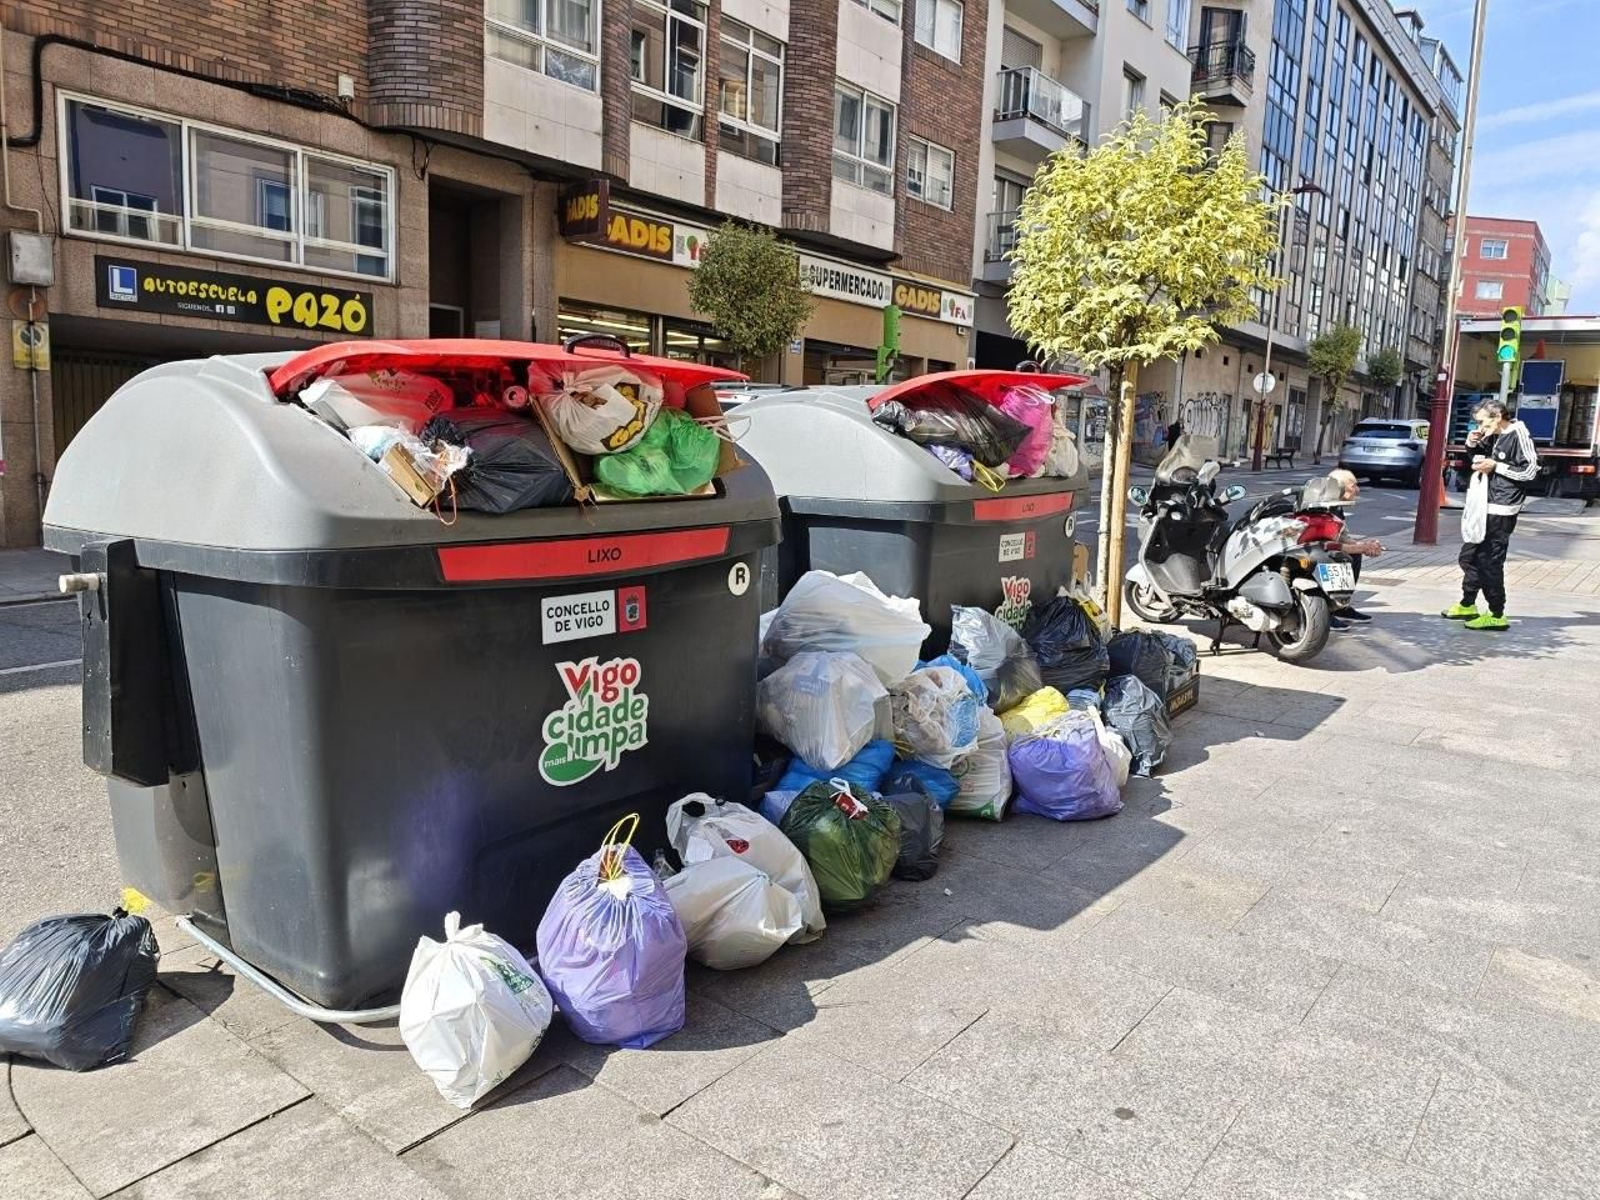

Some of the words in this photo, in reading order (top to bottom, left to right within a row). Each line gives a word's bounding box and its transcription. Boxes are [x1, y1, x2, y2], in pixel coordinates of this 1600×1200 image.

[607, 215, 671, 253] ADIS
[112, 268, 134, 294] L
[143, 277, 258, 305] AUTOESCUELA
[808, 264, 884, 301] SUPERMERCADO
[265, 285, 367, 332] PAZÓ
[895, 284, 941, 314] GADIS
[587, 547, 622, 564] LIXO
[736, 567, 745, 585] R
[1004, 580, 1029, 604] Vigo
[546, 600, 610, 619] CONCELLO
[555, 620, 571, 633] DE
[574, 615, 604, 629] VIGO
[564, 662, 637, 703] Vigo
[547, 687, 645, 740] cidade
[567, 722, 643, 764] limpa
